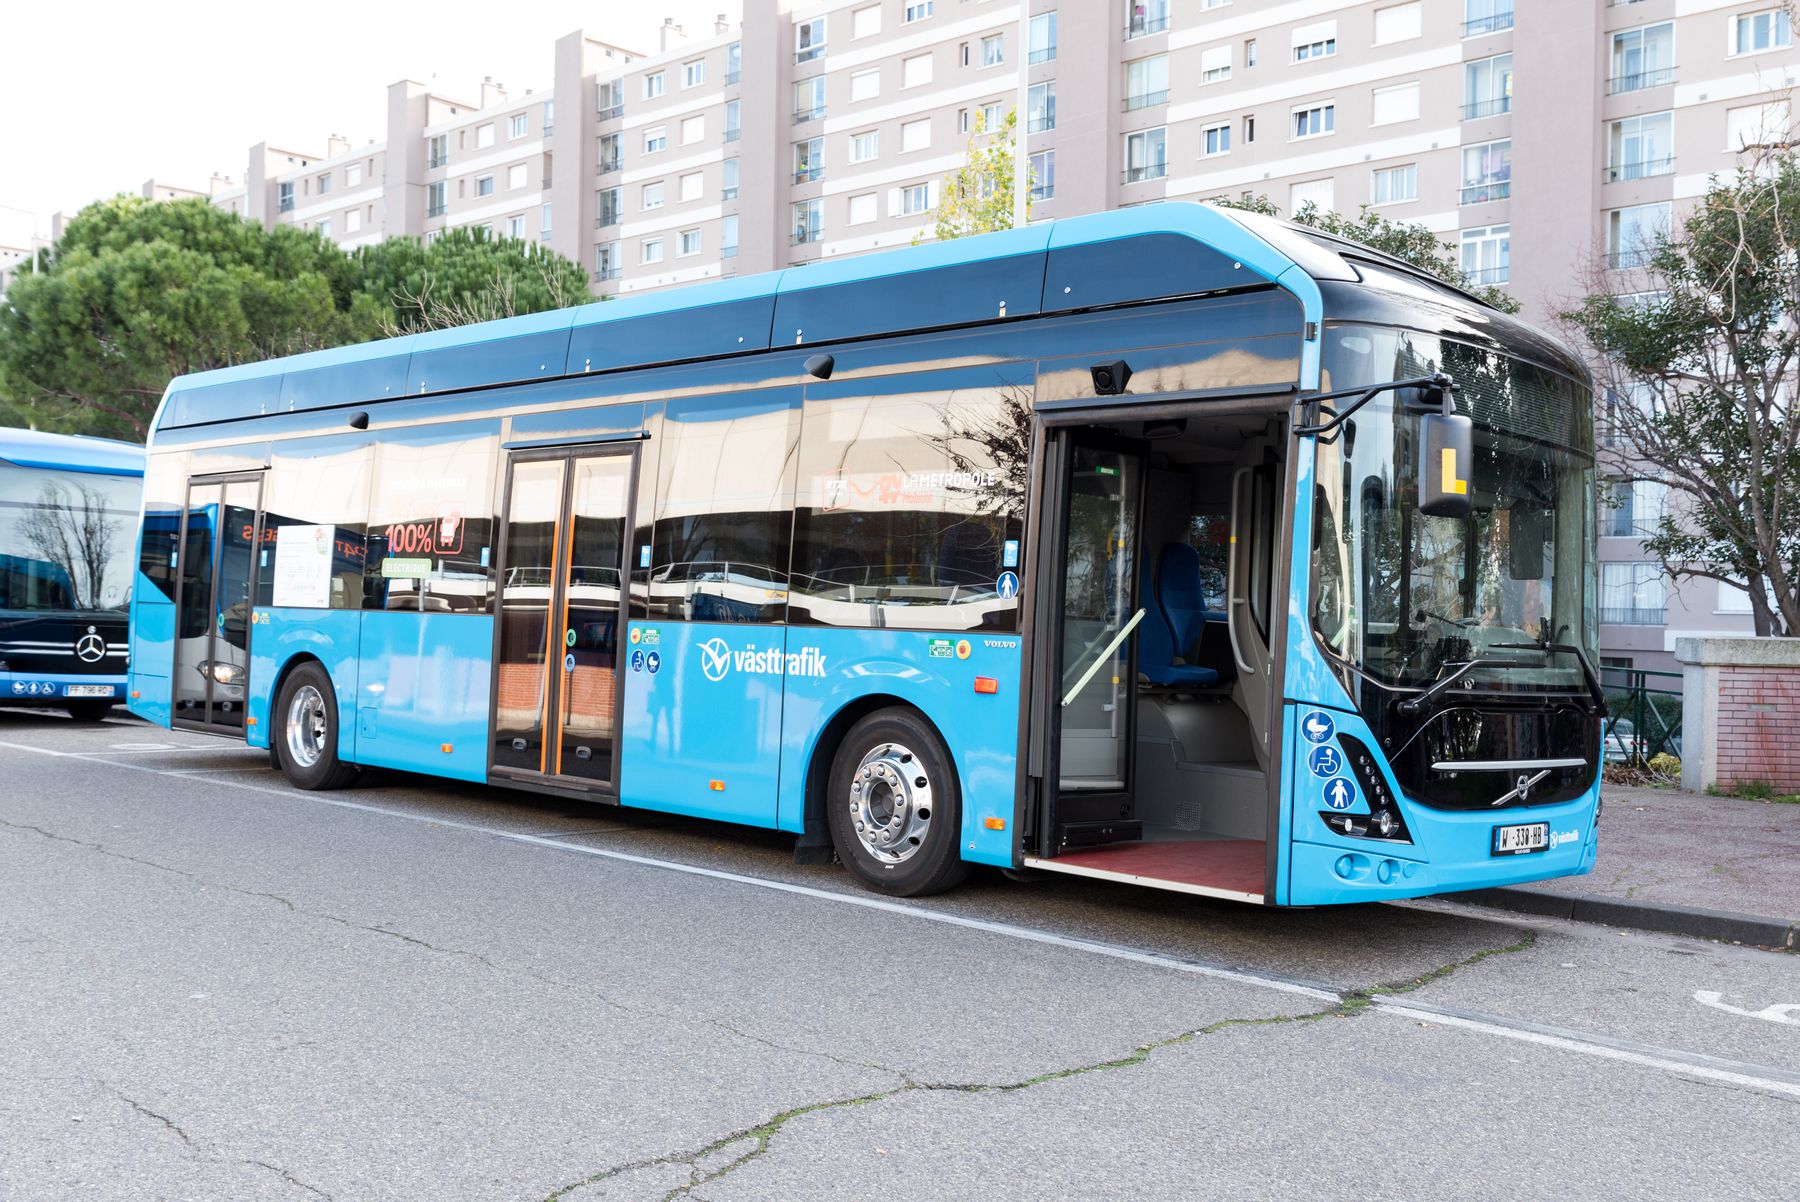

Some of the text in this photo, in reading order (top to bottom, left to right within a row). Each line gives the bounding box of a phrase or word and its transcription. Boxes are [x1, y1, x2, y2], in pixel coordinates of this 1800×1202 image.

[385, 524, 432, 553] 100%
[983, 640, 1017, 649] VOLVO
[734, 643, 827, 678] västtrafik
